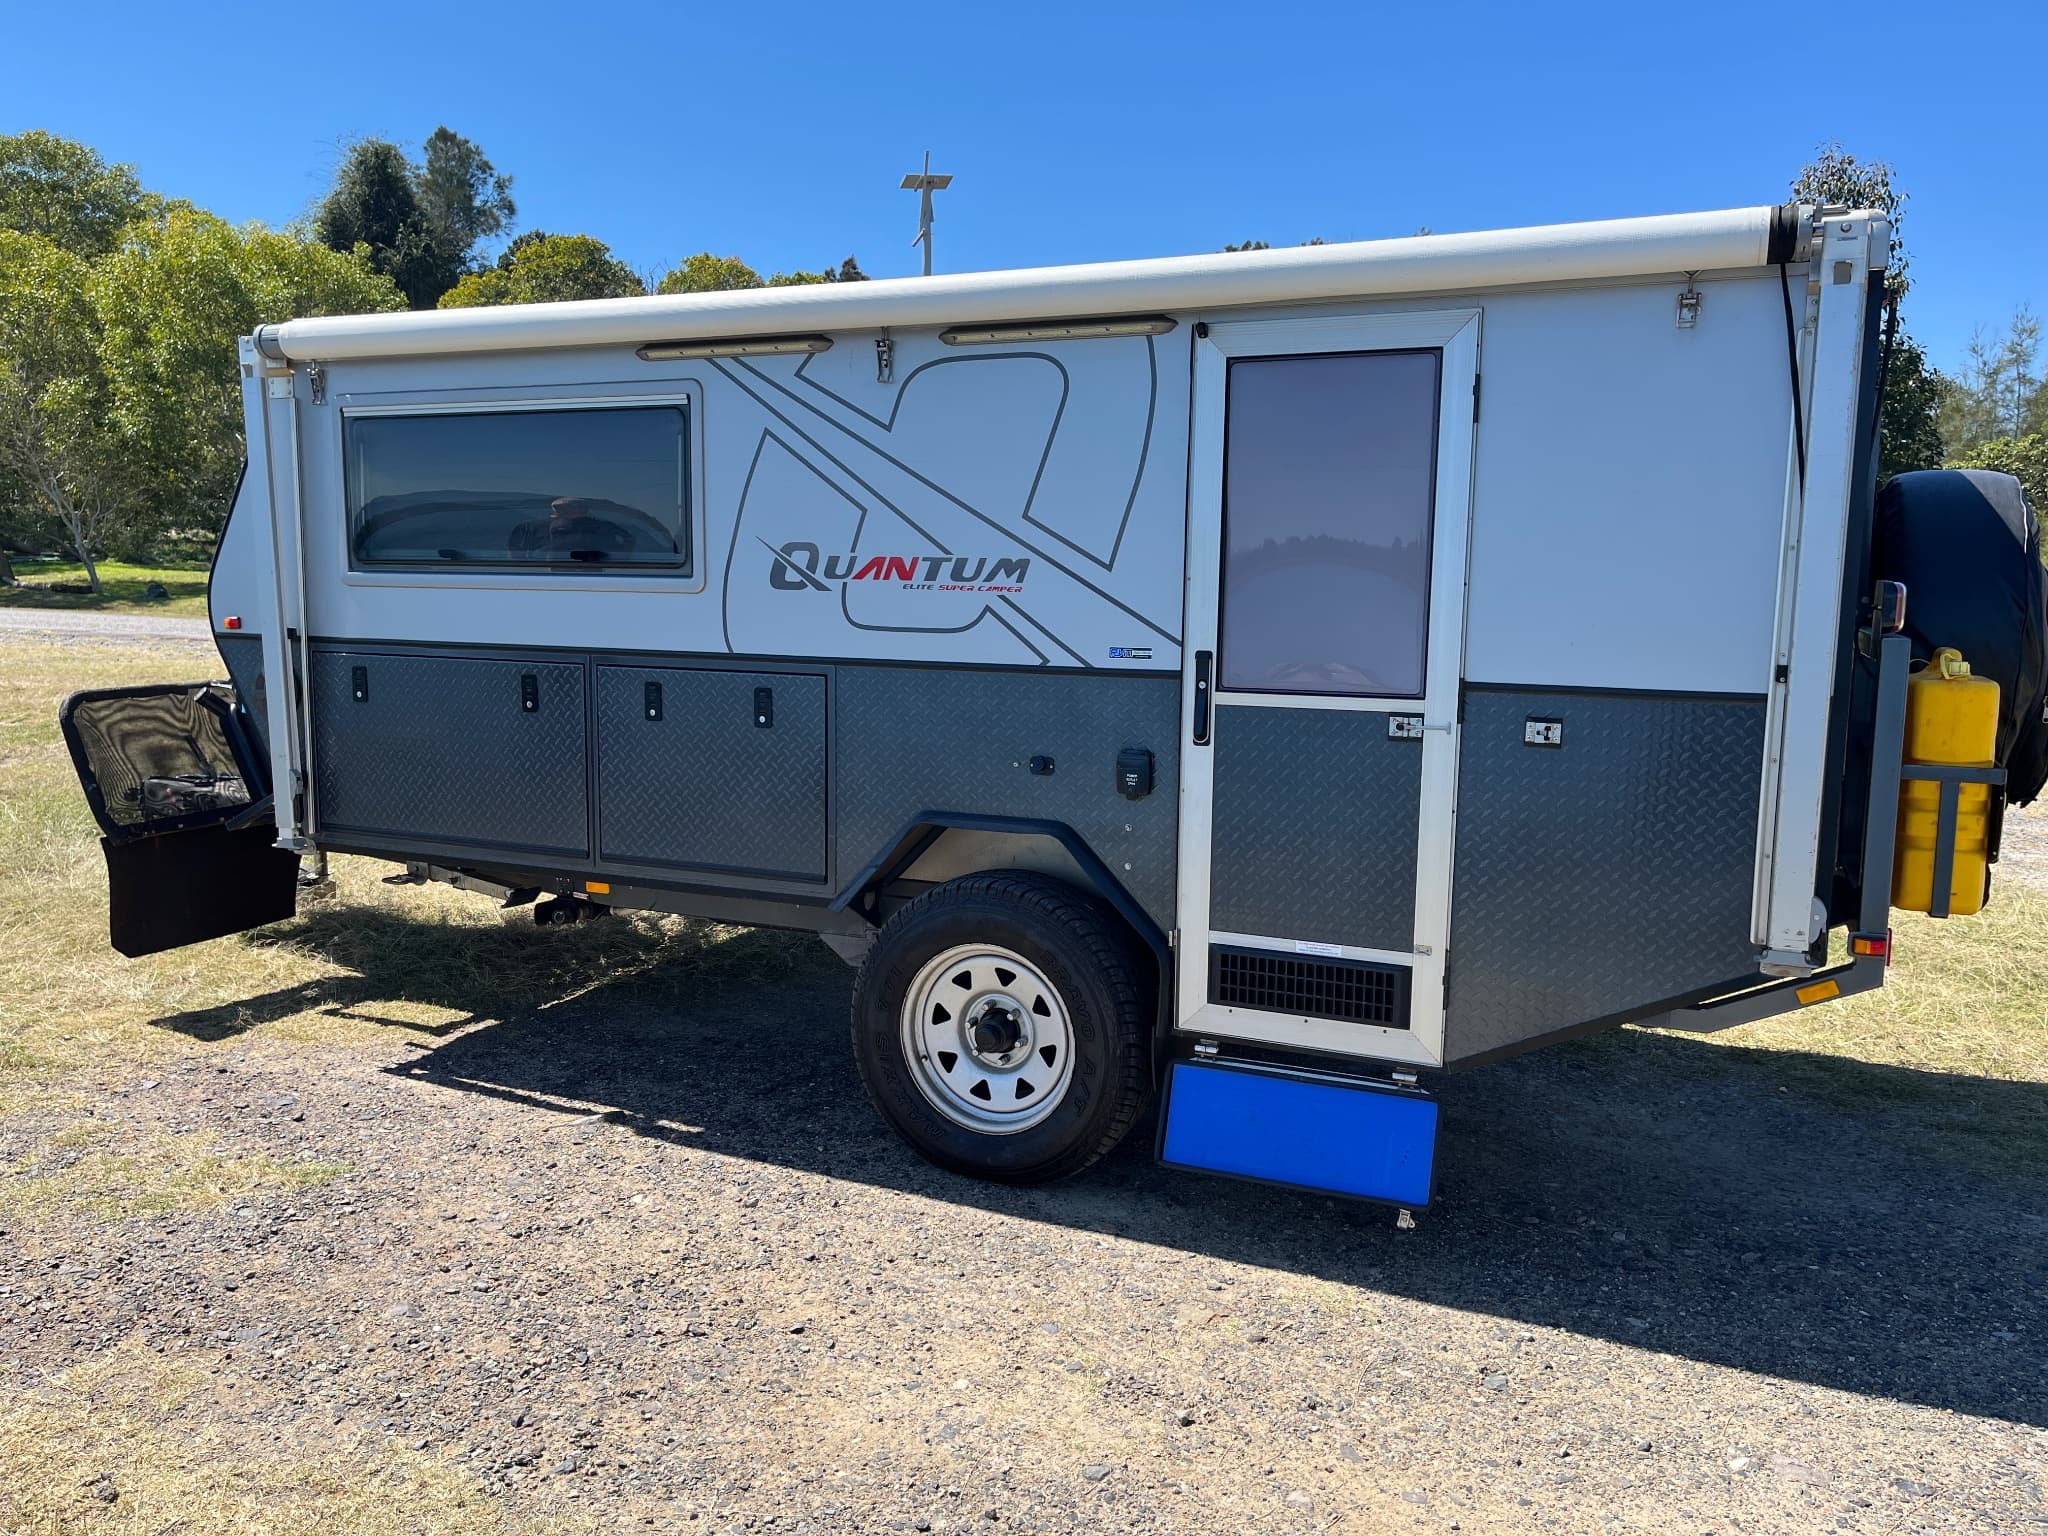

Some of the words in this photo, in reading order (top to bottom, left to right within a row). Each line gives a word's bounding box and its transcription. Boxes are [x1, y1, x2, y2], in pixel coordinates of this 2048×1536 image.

[757, 538, 1031, 592] QUANTUM
[902, 583, 935, 591] ELITE
[938, 584, 975, 592] SUPER
[977, 585, 1023, 593] CAMPER
